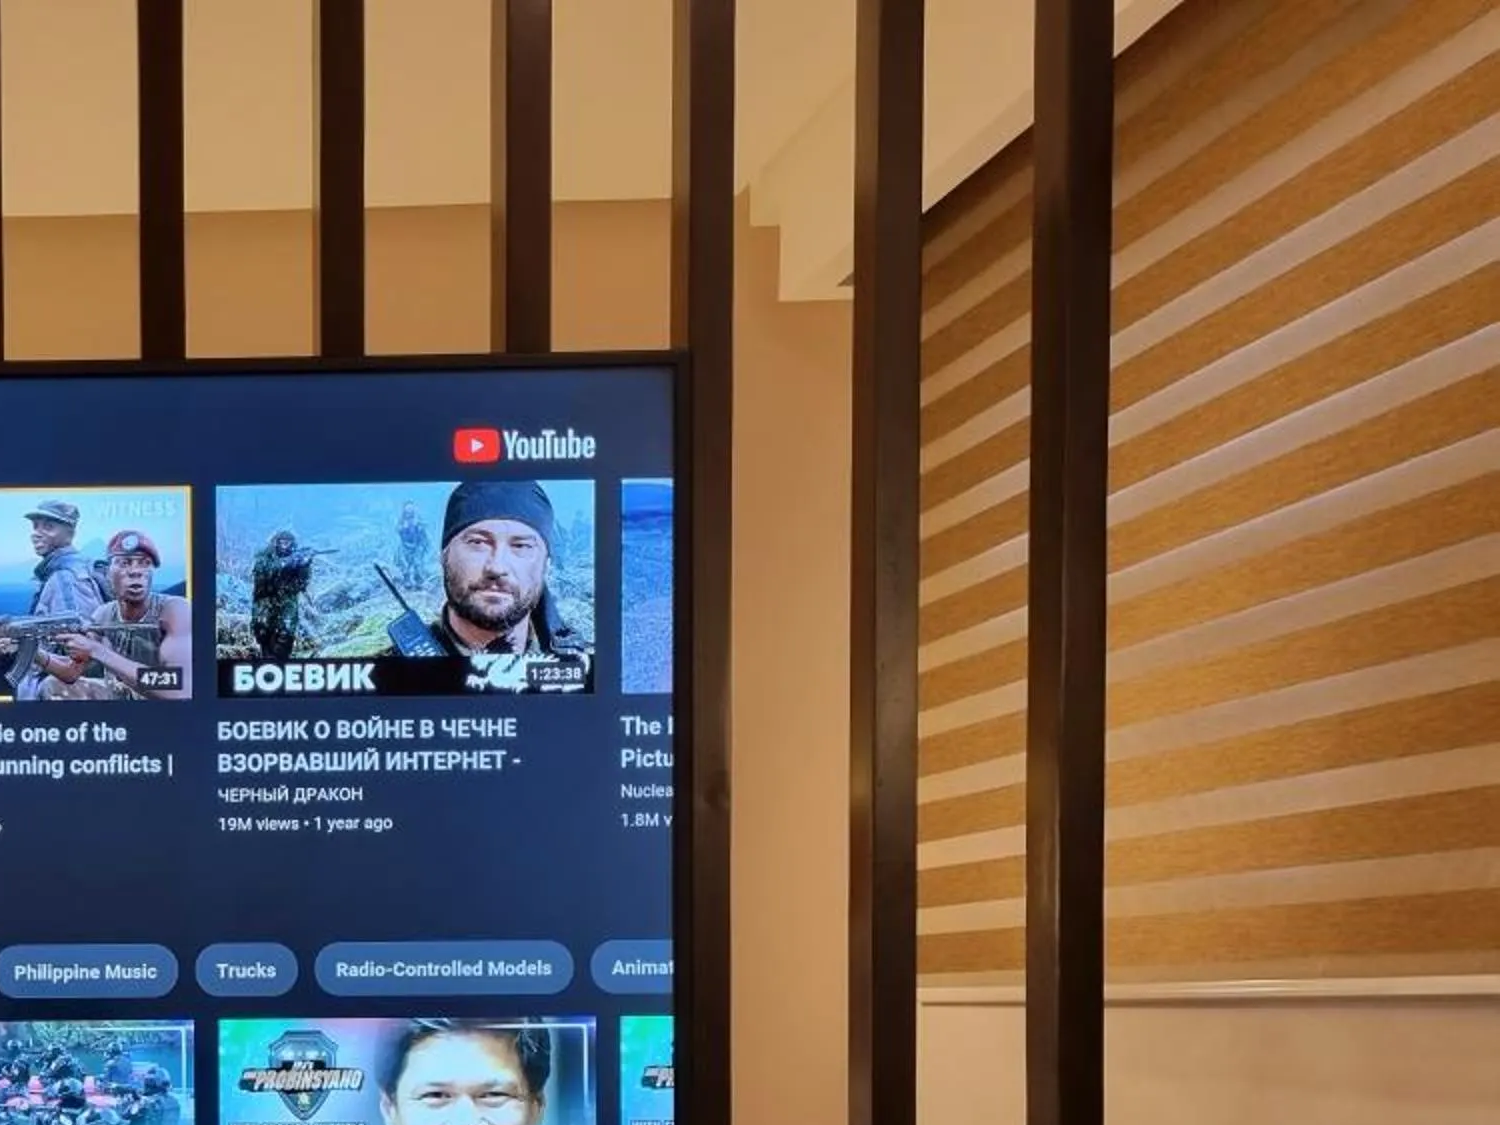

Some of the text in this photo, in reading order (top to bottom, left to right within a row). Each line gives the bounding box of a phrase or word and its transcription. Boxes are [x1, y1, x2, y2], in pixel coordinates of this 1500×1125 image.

[503, 427, 596, 460] YouTube
[140, 671, 177, 686] 47:31
[234, 663, 376, 691] БОЕВИК
[531, 668, 582, 680] 1:23:38
[21, 728, 59, 742] one
[66, 723, 88, 742] of
[92, 723, 127, 741] the
[218, 717, 517, 741] БОЕВИК О ВОЙНЕ В ЧЕЧНЕ
[620, 715, 661, 736] The
[70, 754, 162, 775] conflicts
[218, 749, 380, 774] ВЗОРВАВШИЙ
[386, 751, 506, 771] ИНТЕРНЕТ
[218, 785, 363, 804] ЧЕРНЫЙ ДРАКОН
[219, 817, 252, 831] 19M
[257, 817, 300, 831] views
[315, 816, 322, 830] 1
[328, 818, 359, 834] year
[365, 818, 392, 833] ago
[622, 812, 660, 828] 1.8M
[15, 963, 157, 984] Philippine Music
[217, 963, 277, 979] Trucks
[336, 960, 552, 979] Radio-Controlled Models
